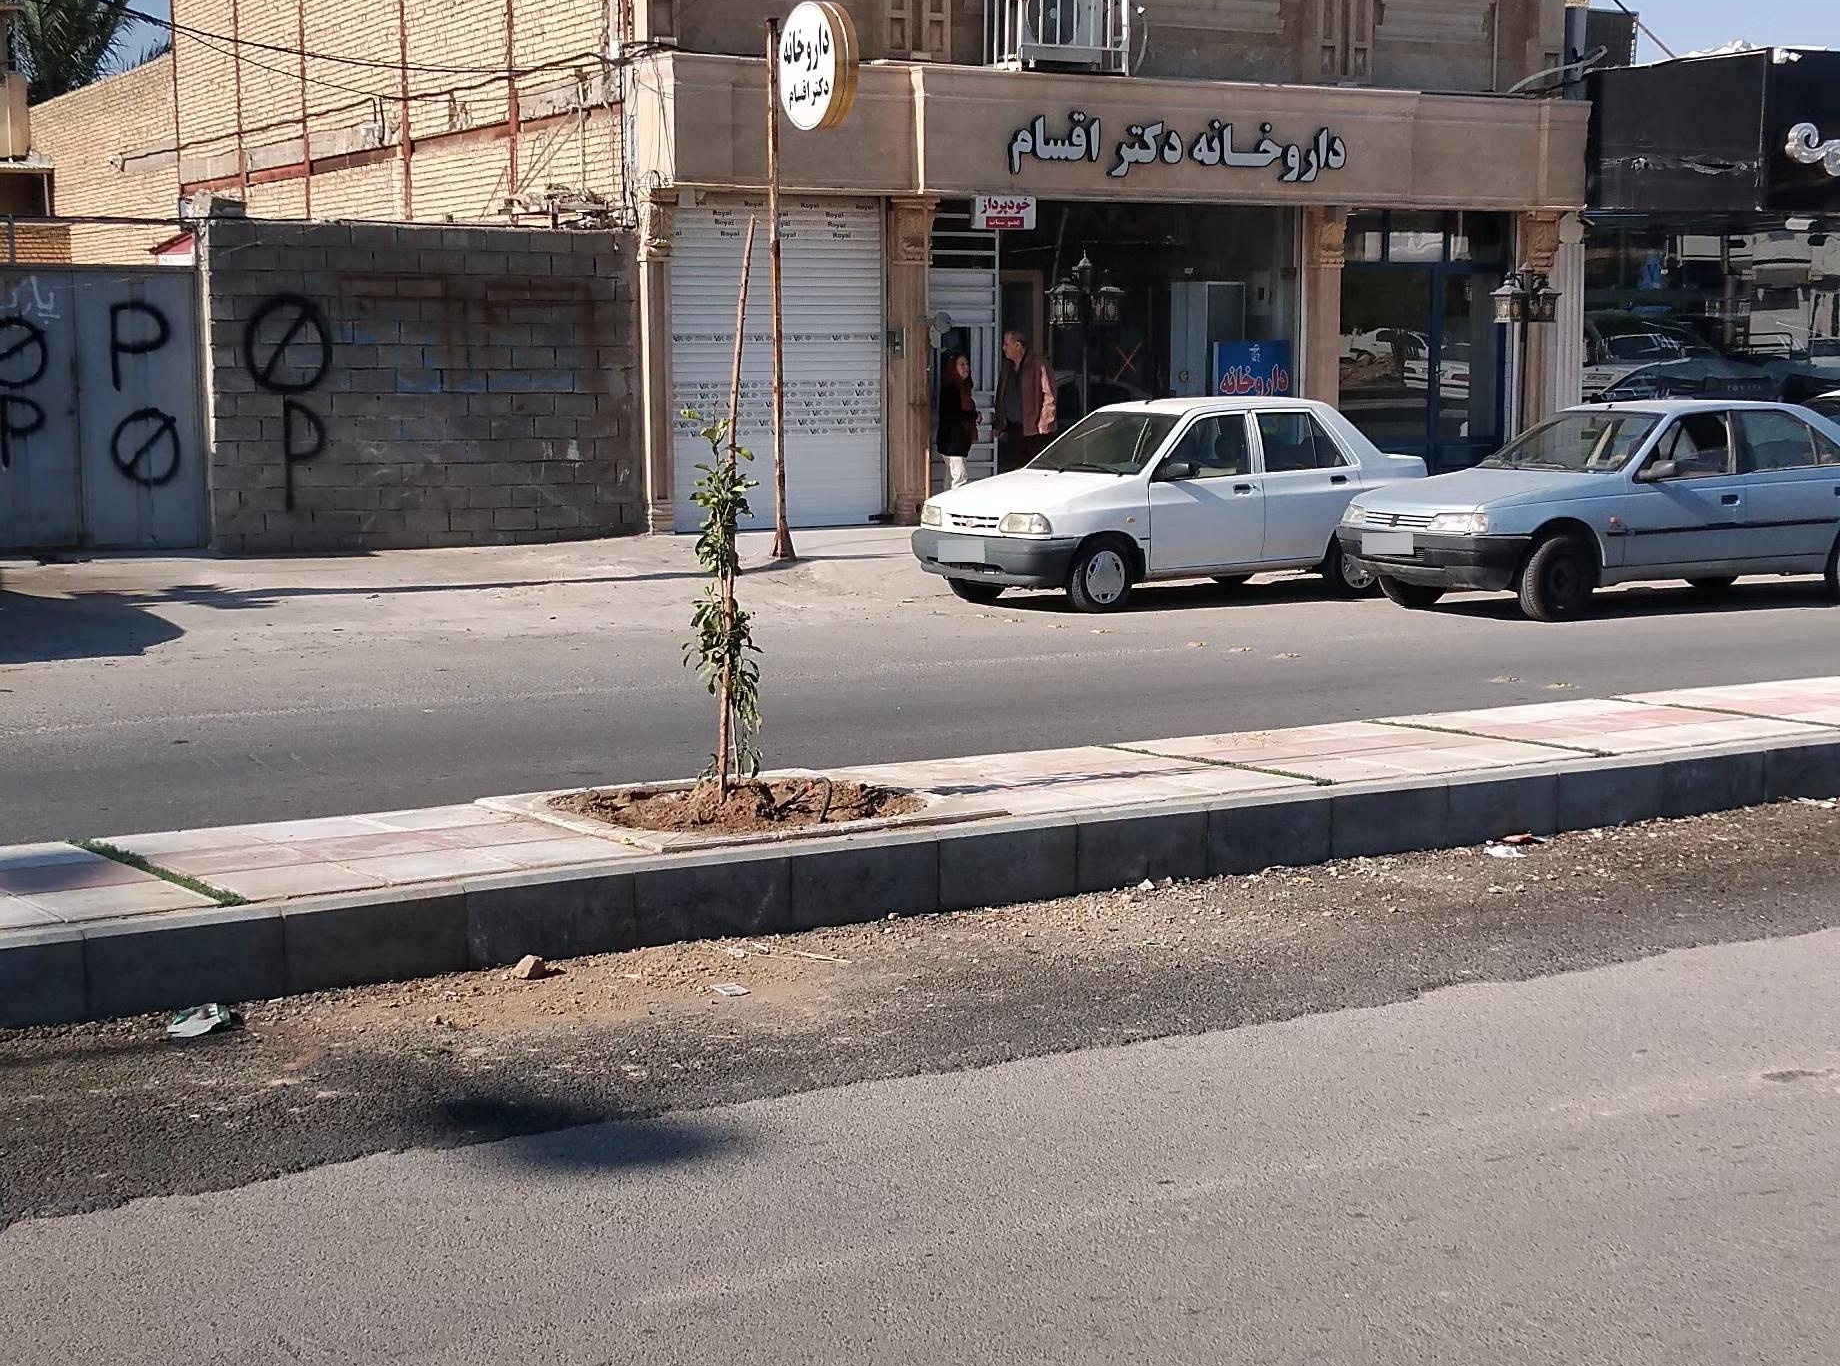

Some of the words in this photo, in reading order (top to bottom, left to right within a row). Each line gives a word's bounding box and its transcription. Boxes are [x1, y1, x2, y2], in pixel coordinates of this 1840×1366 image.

[784, 22, 829, 71] داروخانه
[811, 77, 829, 106] دکتر
[1008, 111, 1101, 175] اقسام
[1106, 121, 1184, 177] دکتر
[1188, 119, 1346, 183] داروخانه
[981, 197, 1031, 214] خودپرداز
[1220, 363, 1289, 396] داروخانه
